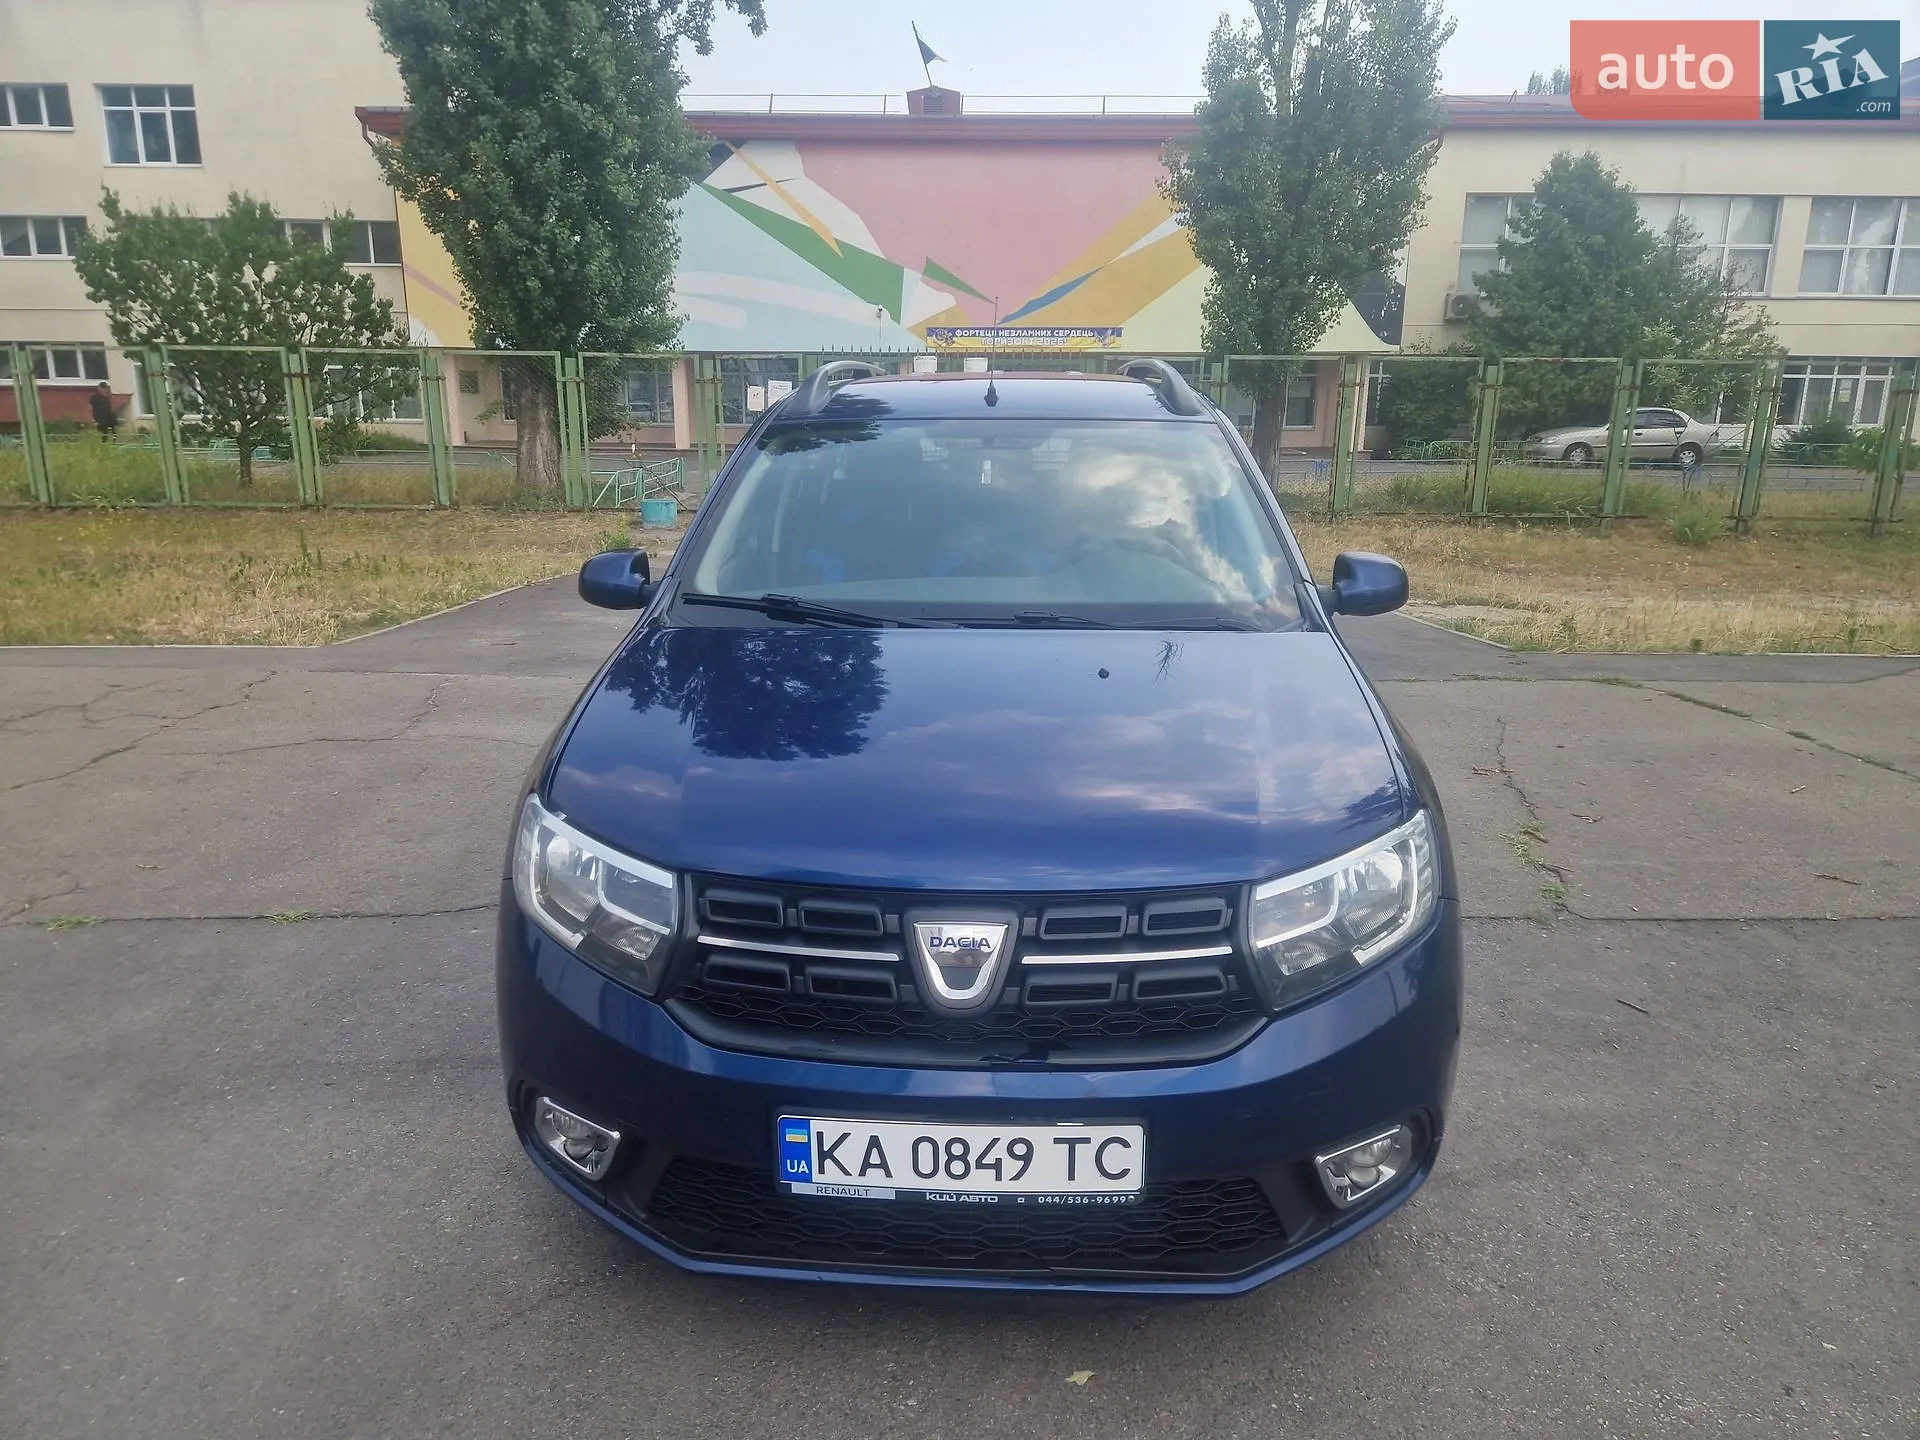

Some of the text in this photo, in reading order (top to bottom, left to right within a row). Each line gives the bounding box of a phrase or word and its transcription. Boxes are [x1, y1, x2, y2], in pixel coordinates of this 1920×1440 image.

[999, 329, 1052, 337] НЕЗЛАМНИХ
[1054, 329, 1094, 338] СЕРДЕЦЬ
[929, 936, 992, 949] DACIA
[815, 1130, 1132, 1182] KA 0849 TC
[786, 1159, 810, 1175] UA
[815, 1186, 871, 1198] RENAULT
